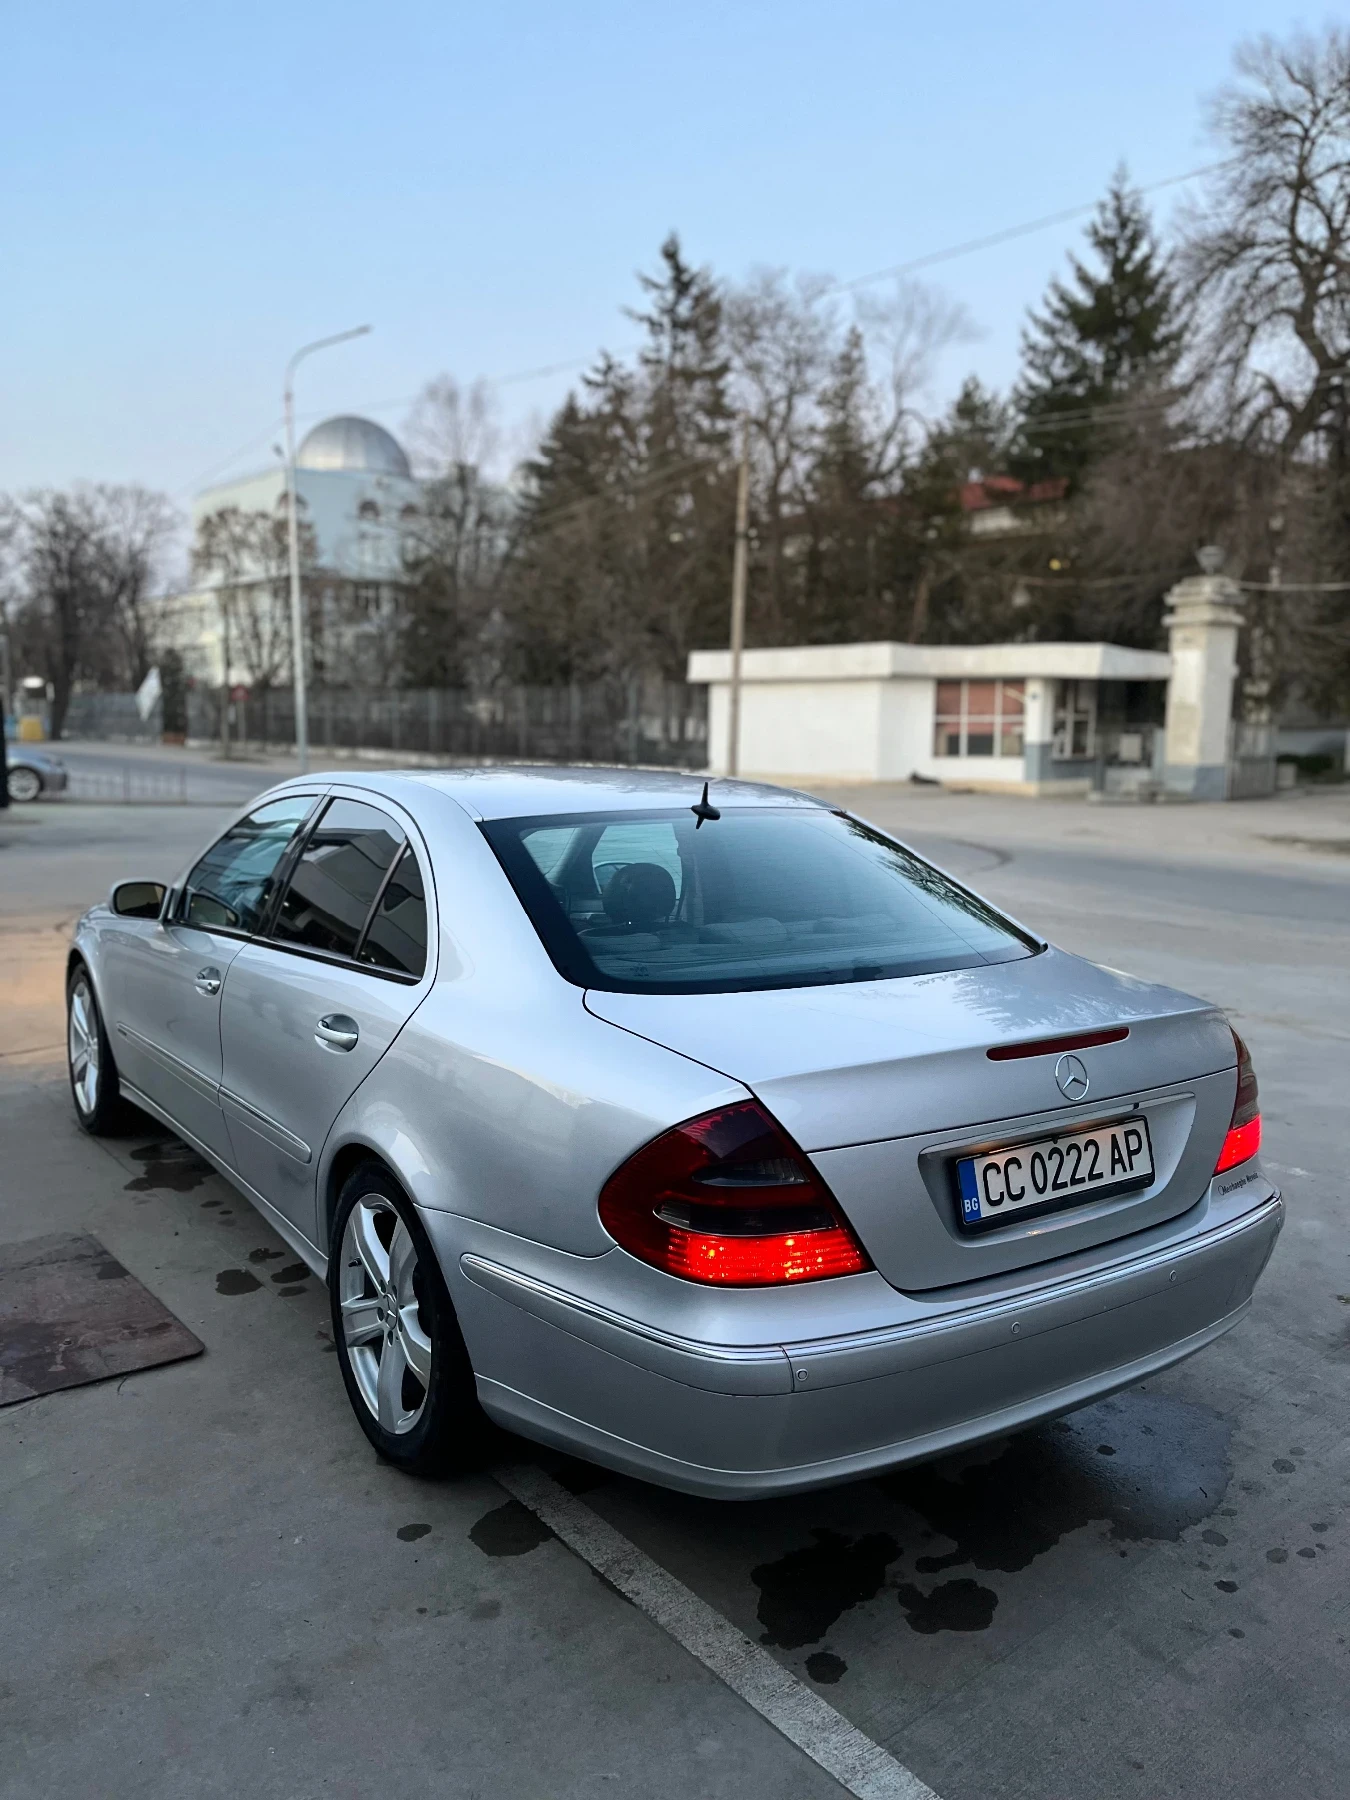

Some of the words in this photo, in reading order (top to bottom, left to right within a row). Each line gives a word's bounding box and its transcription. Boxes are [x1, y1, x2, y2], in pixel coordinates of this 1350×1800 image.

[982, 1156, 1026, 1207] CC
[1030, 1138, 1104, 1195] 0222
[1110, 1128, 1143, 1176] AP
[964, 1197, 979, 1213] BG
